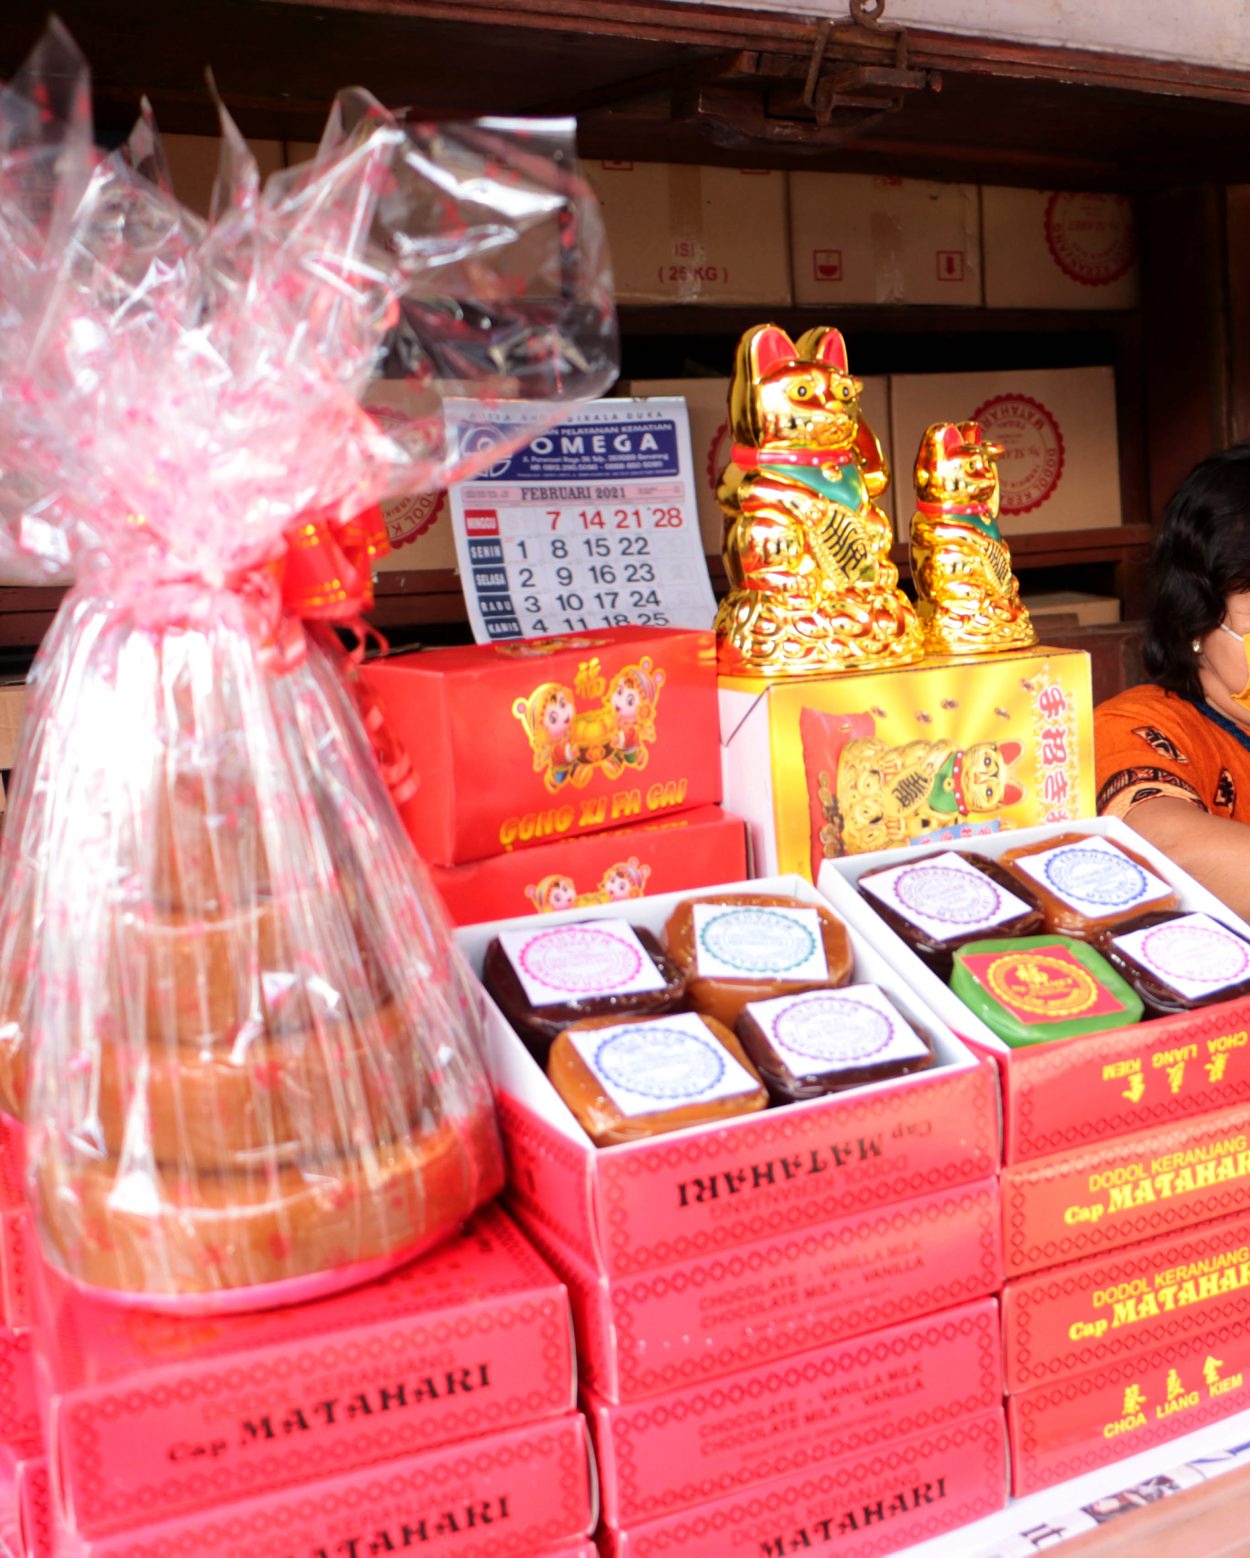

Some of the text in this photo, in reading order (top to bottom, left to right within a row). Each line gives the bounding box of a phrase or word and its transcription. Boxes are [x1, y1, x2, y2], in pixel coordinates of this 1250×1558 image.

[530, 432, 659, 455] OMEGA
[520, 487, 592, 501] FEBRUARI
[595, 487, 626, 500] 2021
[546, 511, 561, 530] 7
[578, 510, 606, 530] 14
[614, 509, 642, 529] 21
[652, 507, 683, 528] 28
[470, 537, 650, 559] SENIN 1 8 15 22
[476, 563, 655, 587] SELASA 2 9 16 23
[480, 590, 661, 613] RABU 3 10 17 24
[487, 613, 670, 634] KAMIS 4 11 18 25
[499, 804, 575, 845] GONG
[579, 796, 608, 826] XI
[611, 788, 642, 819] FA
[1102, 1031, 1248, 1080] CHOA LIANG KIEM
[676, 1137, 882, 1207] MATAHARI
[1089, 1135, 1248, 1192] DODOL KERANJANG
[1064, 1203, 1104, 1225] Cap
[1092, 1247, 1250, 1308] DODOL KERANJANG
[1069, 1319, 1108, 1341] Cap
[240, 1362, 492, 1445] MATAHARI
[1103, 1374, 1244, 1438] CHOA LIANG KIEM
[306, 1495, 510, 1558] TAHARI
[760, 1476, 947, 1558] MATAHARI
